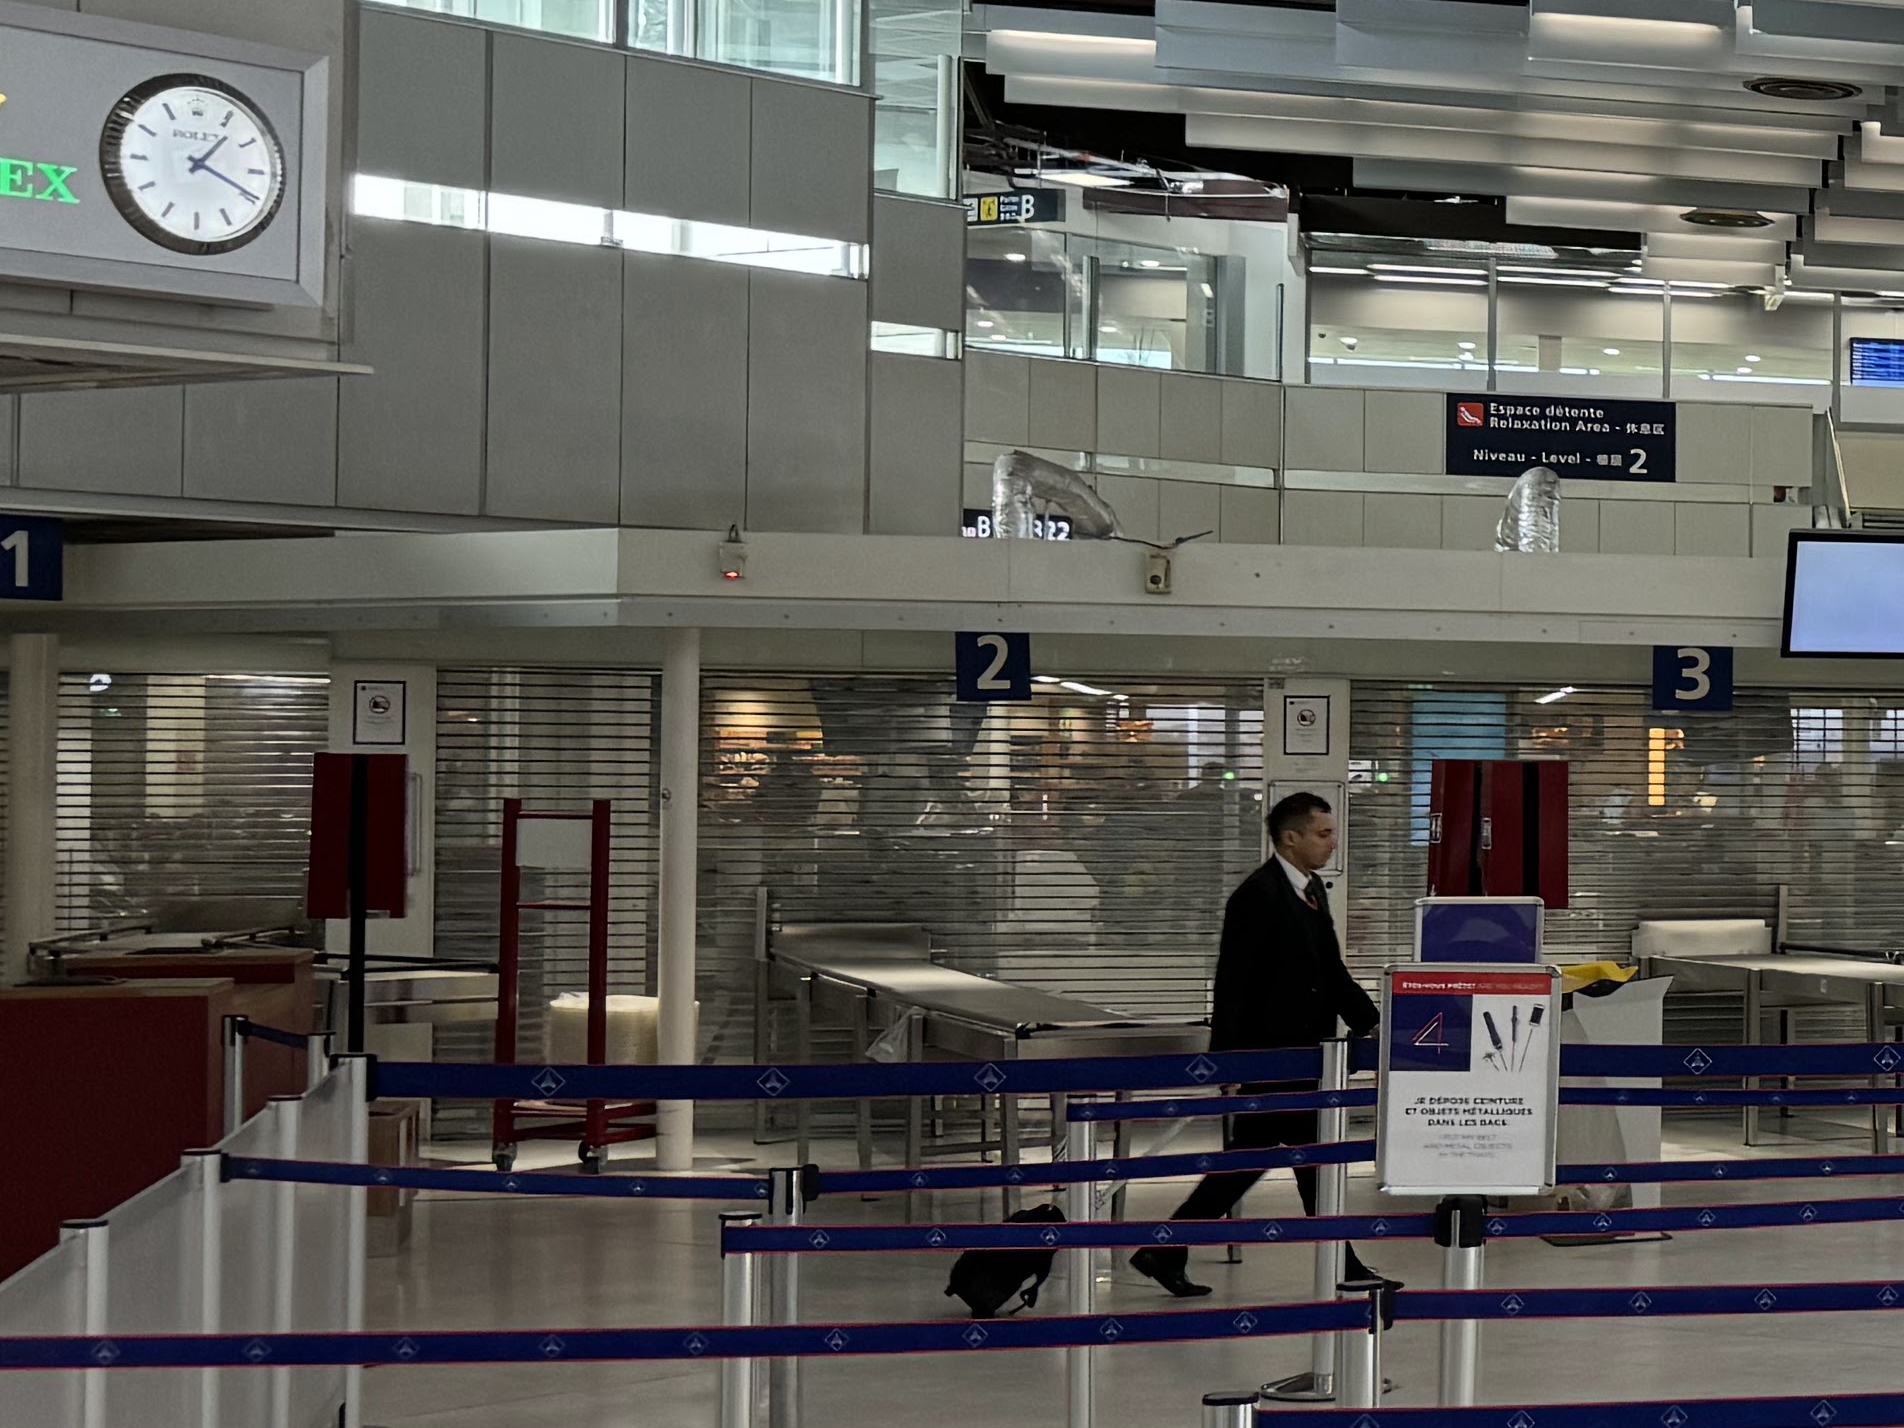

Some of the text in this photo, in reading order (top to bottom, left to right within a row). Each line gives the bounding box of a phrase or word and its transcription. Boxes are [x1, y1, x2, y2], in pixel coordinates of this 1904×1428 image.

[1021, 194, 1035, 220] B
[1490, 403, 1604, 419] Espace détente
[1490, 418, 1570, 432] Relaxation
[1575, 421, 1610, 433] Area
[1473, 449, 1526, 462] Niveau
[1542, 452, 1581, 464] Level
[1629, 448, 1648, 474] 2
[0, 530, 28, 587] 1
[977, 634, 1011, 690] 2
[1675, 647, 1711, 701] 3
[1412, 1012, 1449, 1055] 4
